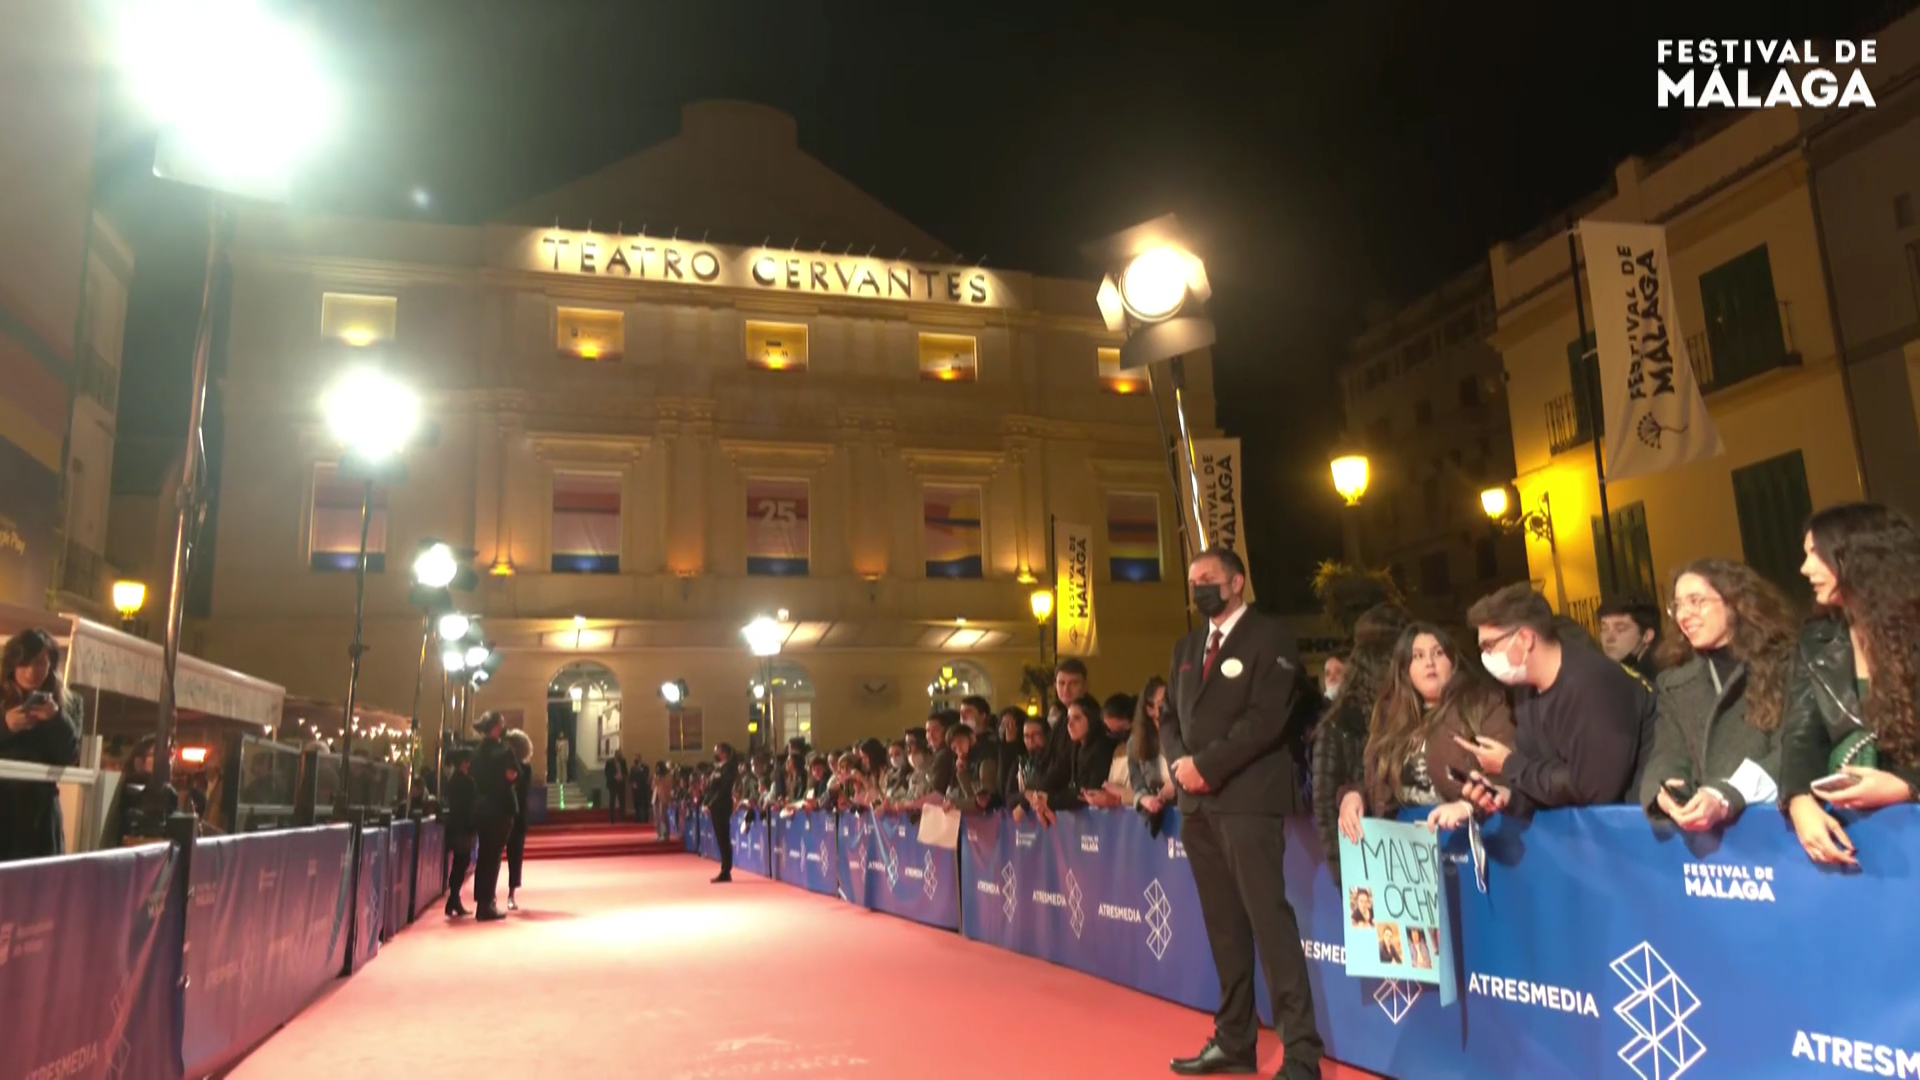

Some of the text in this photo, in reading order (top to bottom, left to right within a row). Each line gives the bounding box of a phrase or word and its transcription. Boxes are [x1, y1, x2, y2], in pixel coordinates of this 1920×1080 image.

[543, 237, 987, 303] TEATRO CERVANTES
[1617, 244, 1647, 400] FESTIVAL DE
[758, 500, 797, 528] 25
[1202, 454, 1219, 548] ESTIVAL DE
[1683, 863, 1774, 881] FESTIVAL DE
[1032, 889, 1068, 908] ATRESMEDIA
[1098, 903, 1142, 924] ATRESMEDIA
[1300, 939, 1346, 965] ESMED
[1468, 971, 1600, 1019] ATRESMEDIA
[1791, 1029, 1920, 1080] ATRESM
